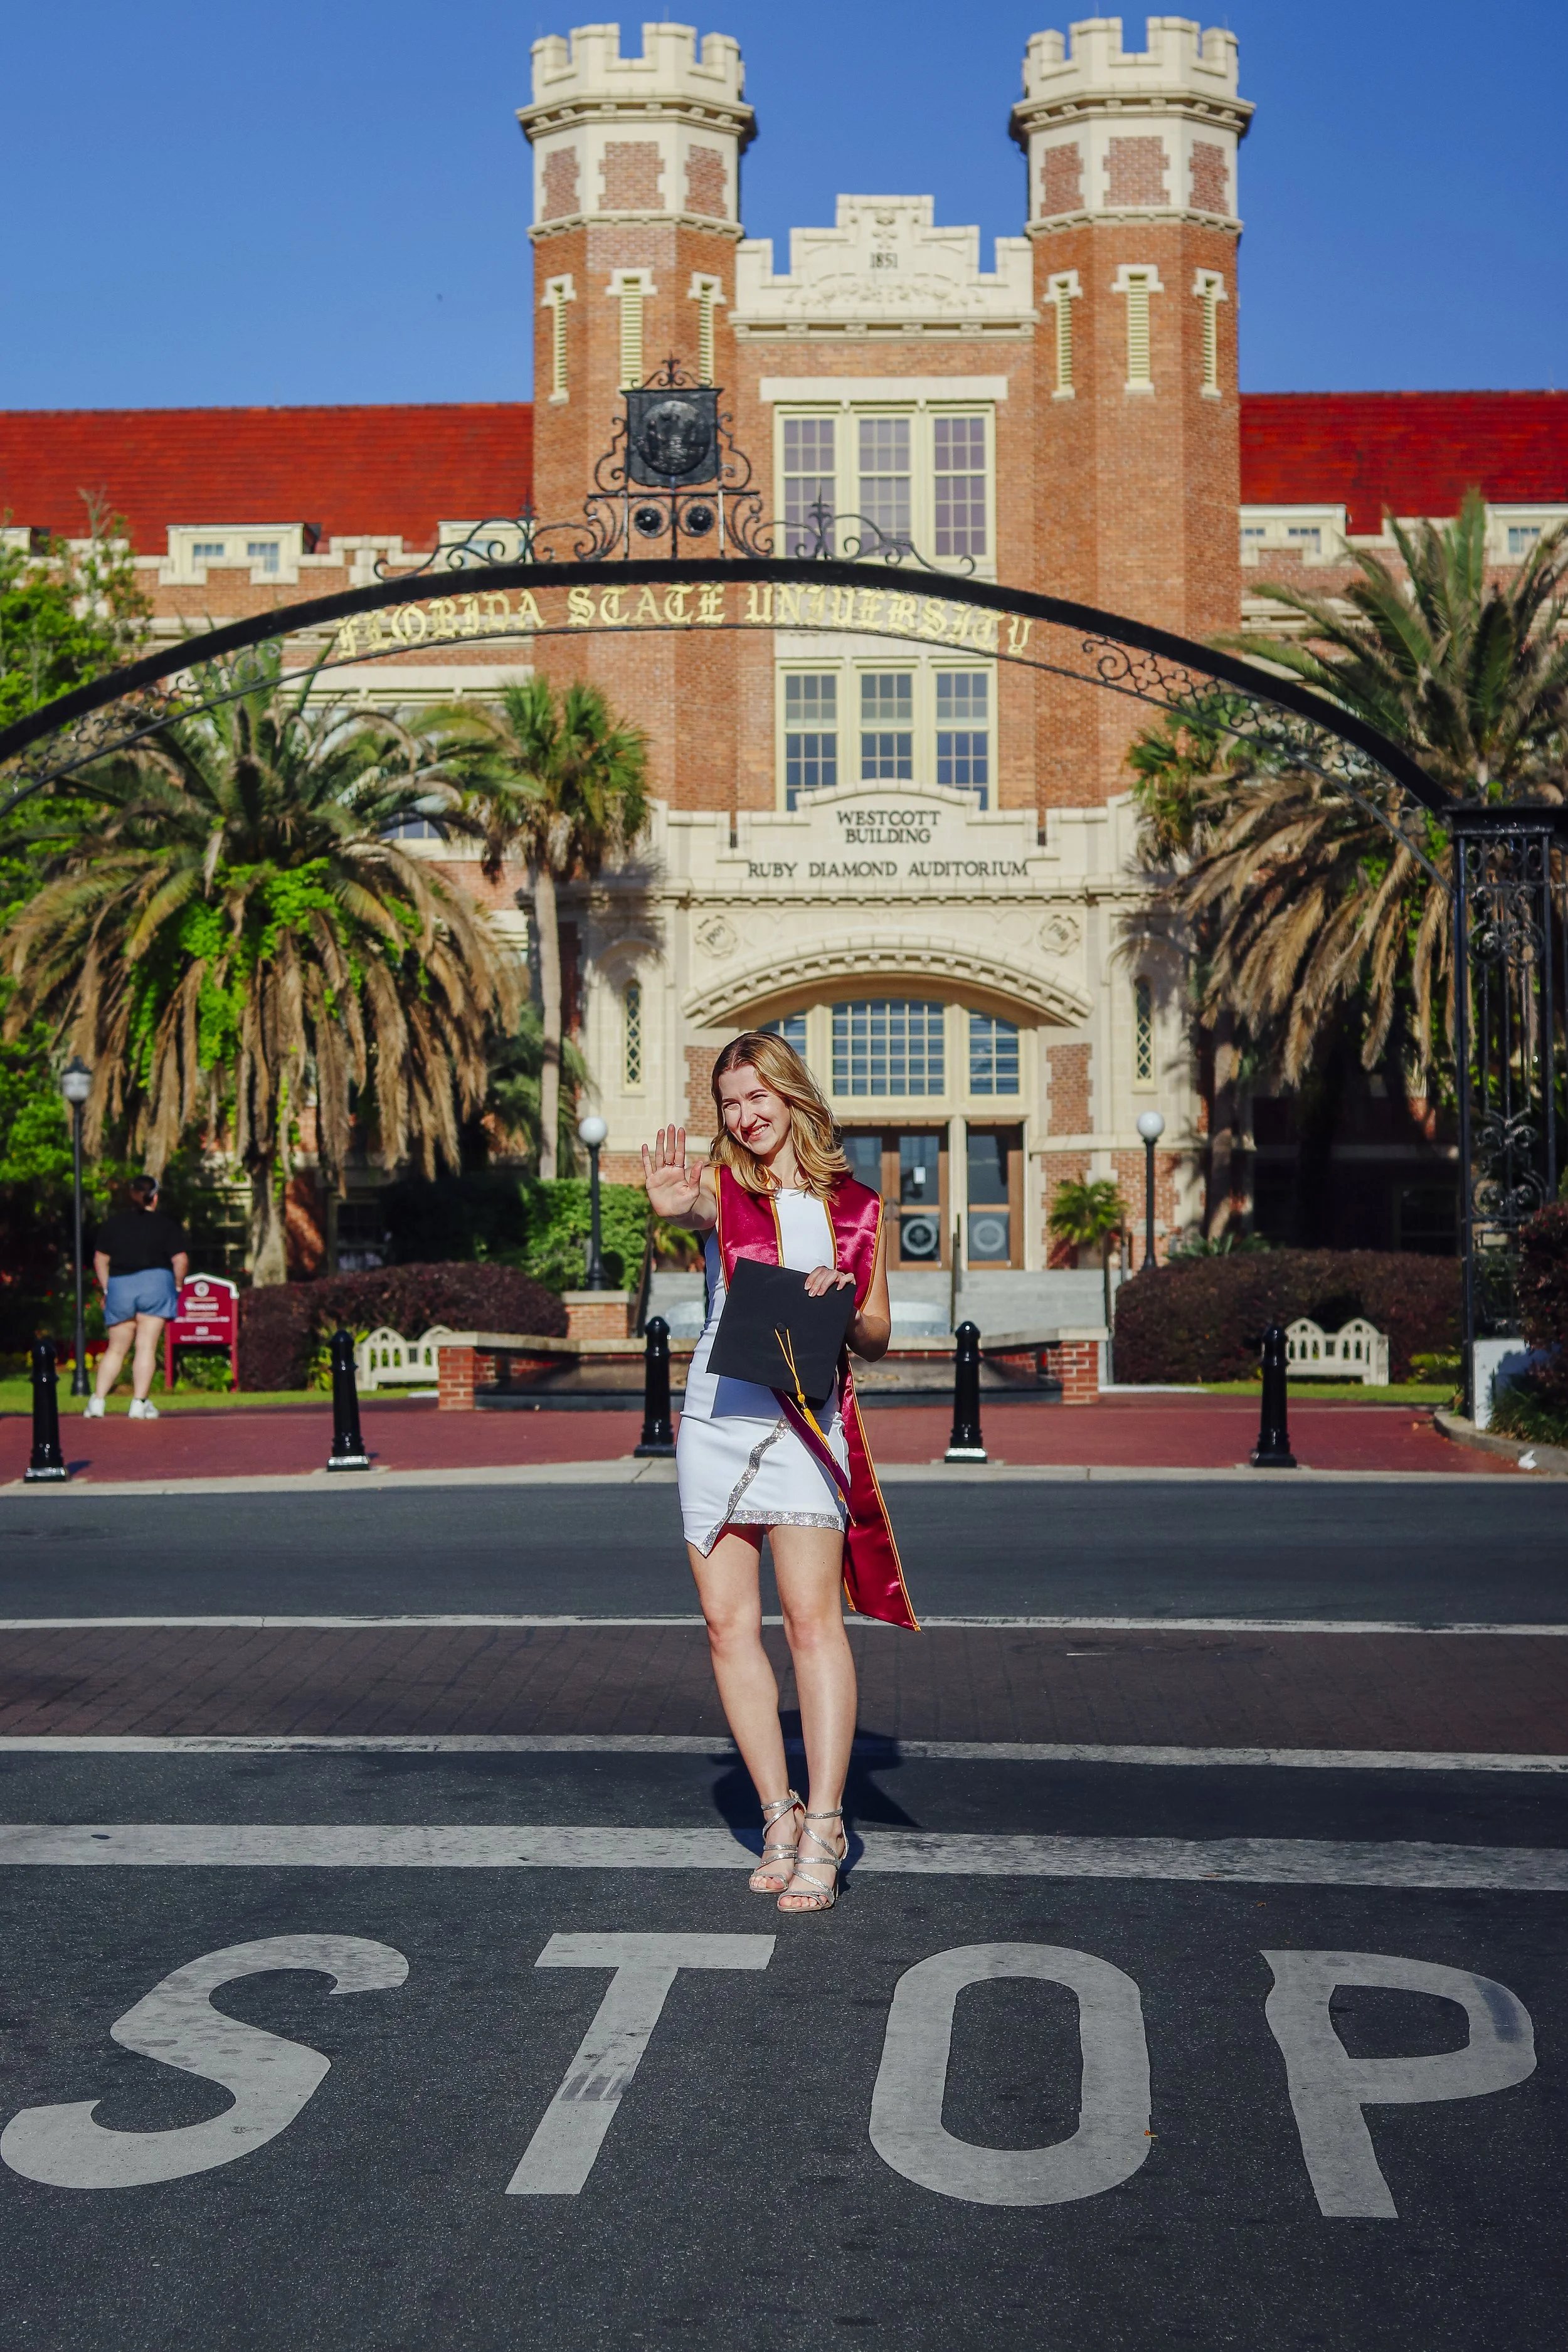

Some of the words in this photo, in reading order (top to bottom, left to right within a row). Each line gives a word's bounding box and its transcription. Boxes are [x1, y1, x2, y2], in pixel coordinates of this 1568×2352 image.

[869, 252, 898, 269] 1851
[336, 589, 546, 659] FLORIDA
[567, 583, 726, 625] STATE
[744, 583, 1033, 656] UNIVERSITY
[837, 810, 941, 826] WESTCOTT
[845, 829, 931, 844] BUILDING
[750, 862, 797, 877] RUBY
[809, 862, 897, 876] DIAMOND
[908, 861, 1029, 876] AUDITORIUM
[0, 1934, 1537, 2218] STOP
